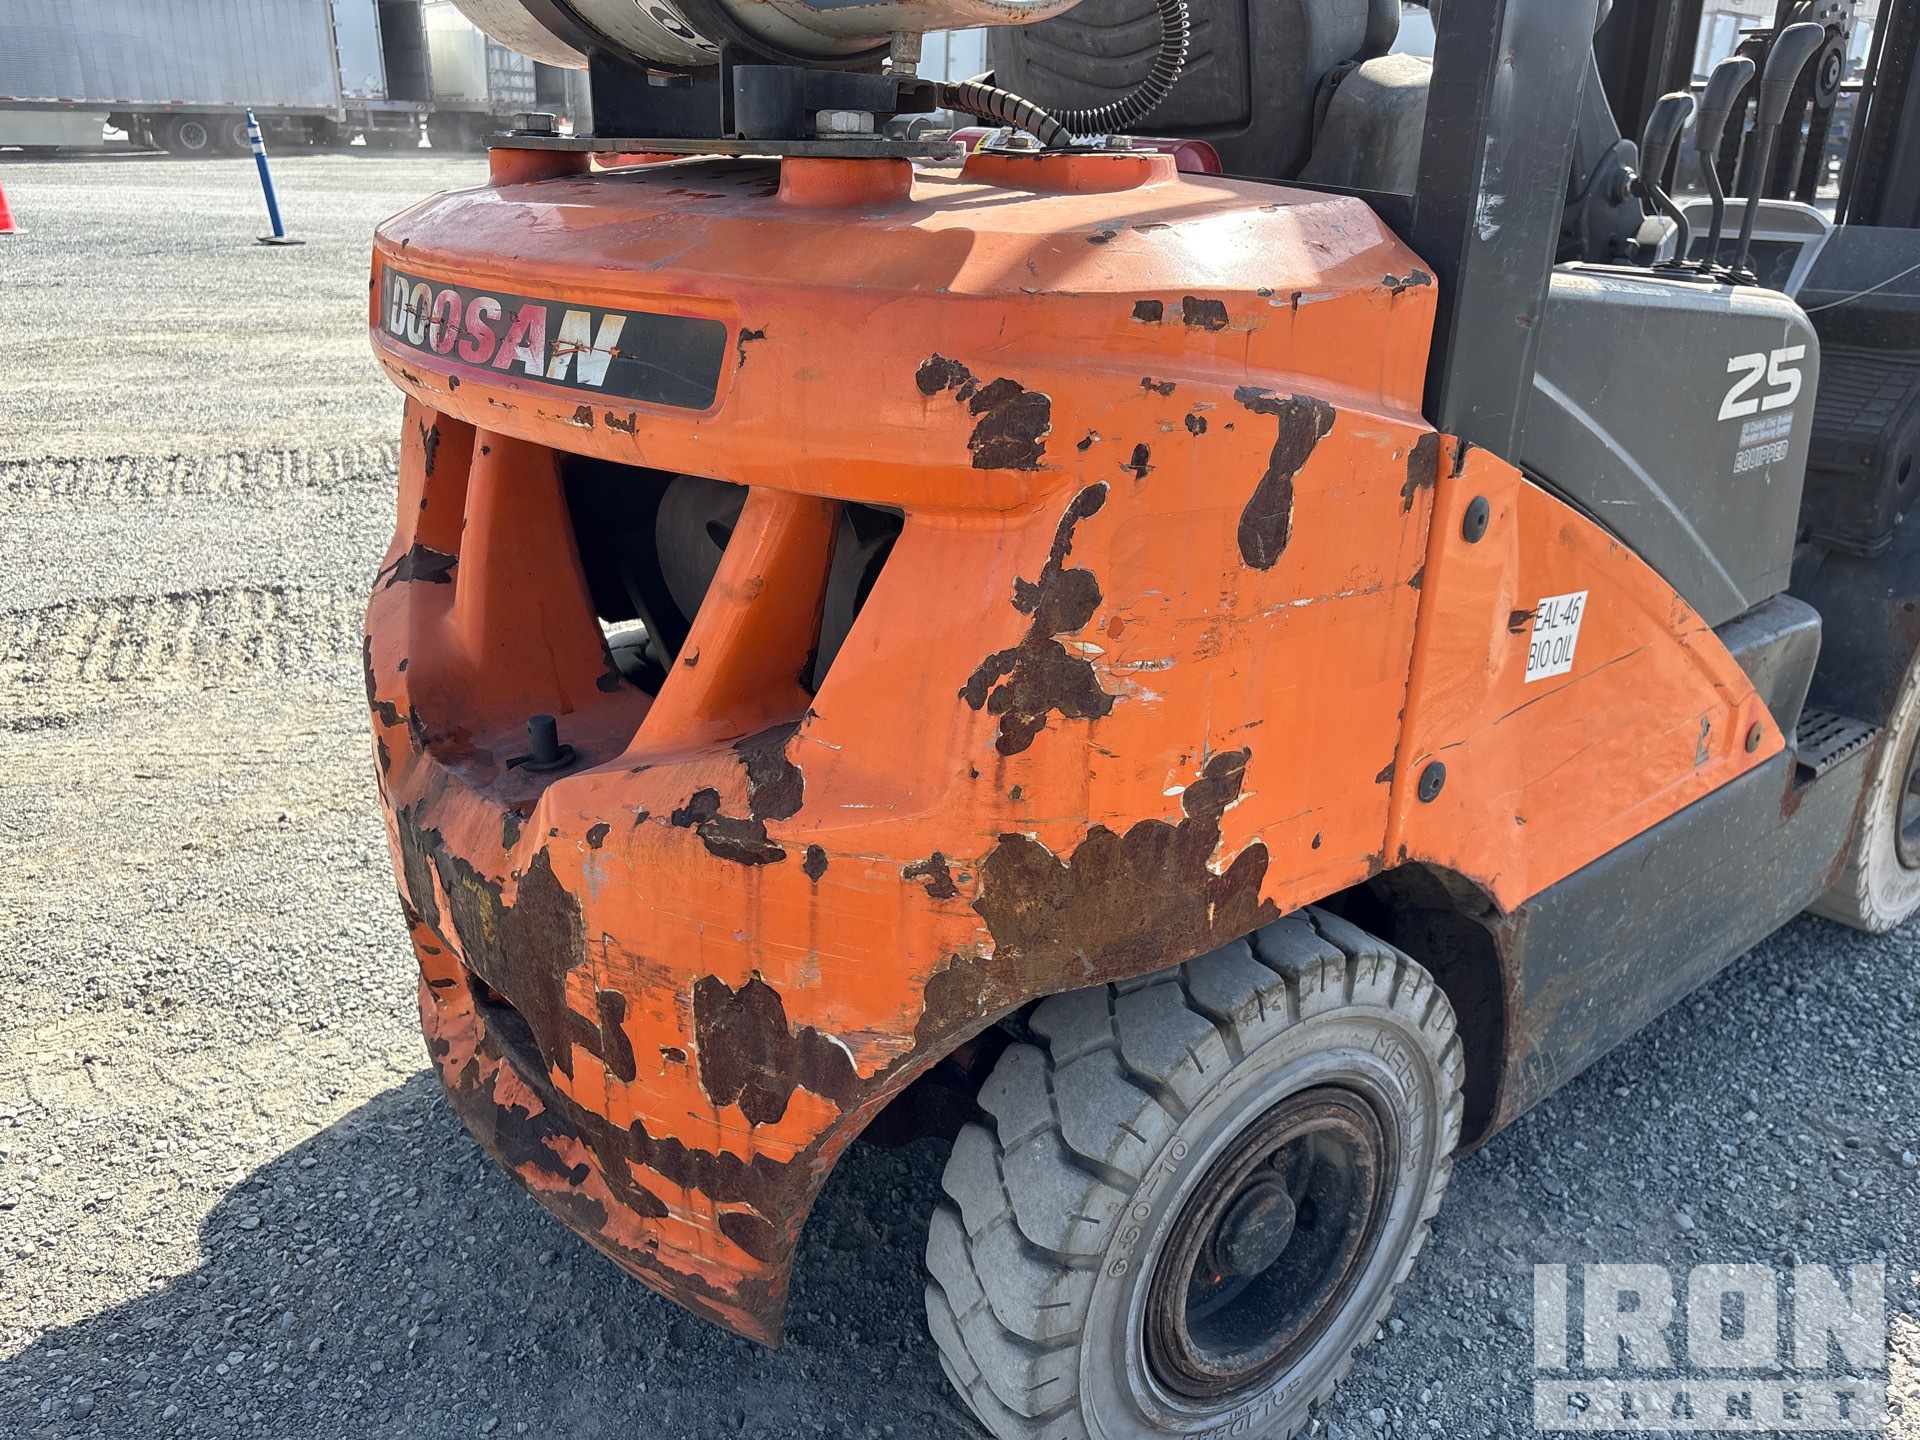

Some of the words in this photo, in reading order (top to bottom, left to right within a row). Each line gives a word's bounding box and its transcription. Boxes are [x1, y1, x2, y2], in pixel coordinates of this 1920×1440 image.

[390, 275, 627, 387] DOOSAN
[1717, 344, 1806, 422] 25
[1733, 439, 1788, 473] EQUIPPED
[1533, 596, 1582, 632] EAL-46
[1527, 639, 1551, 671] BIO
[1552, 634, 1572, 665] OIL
